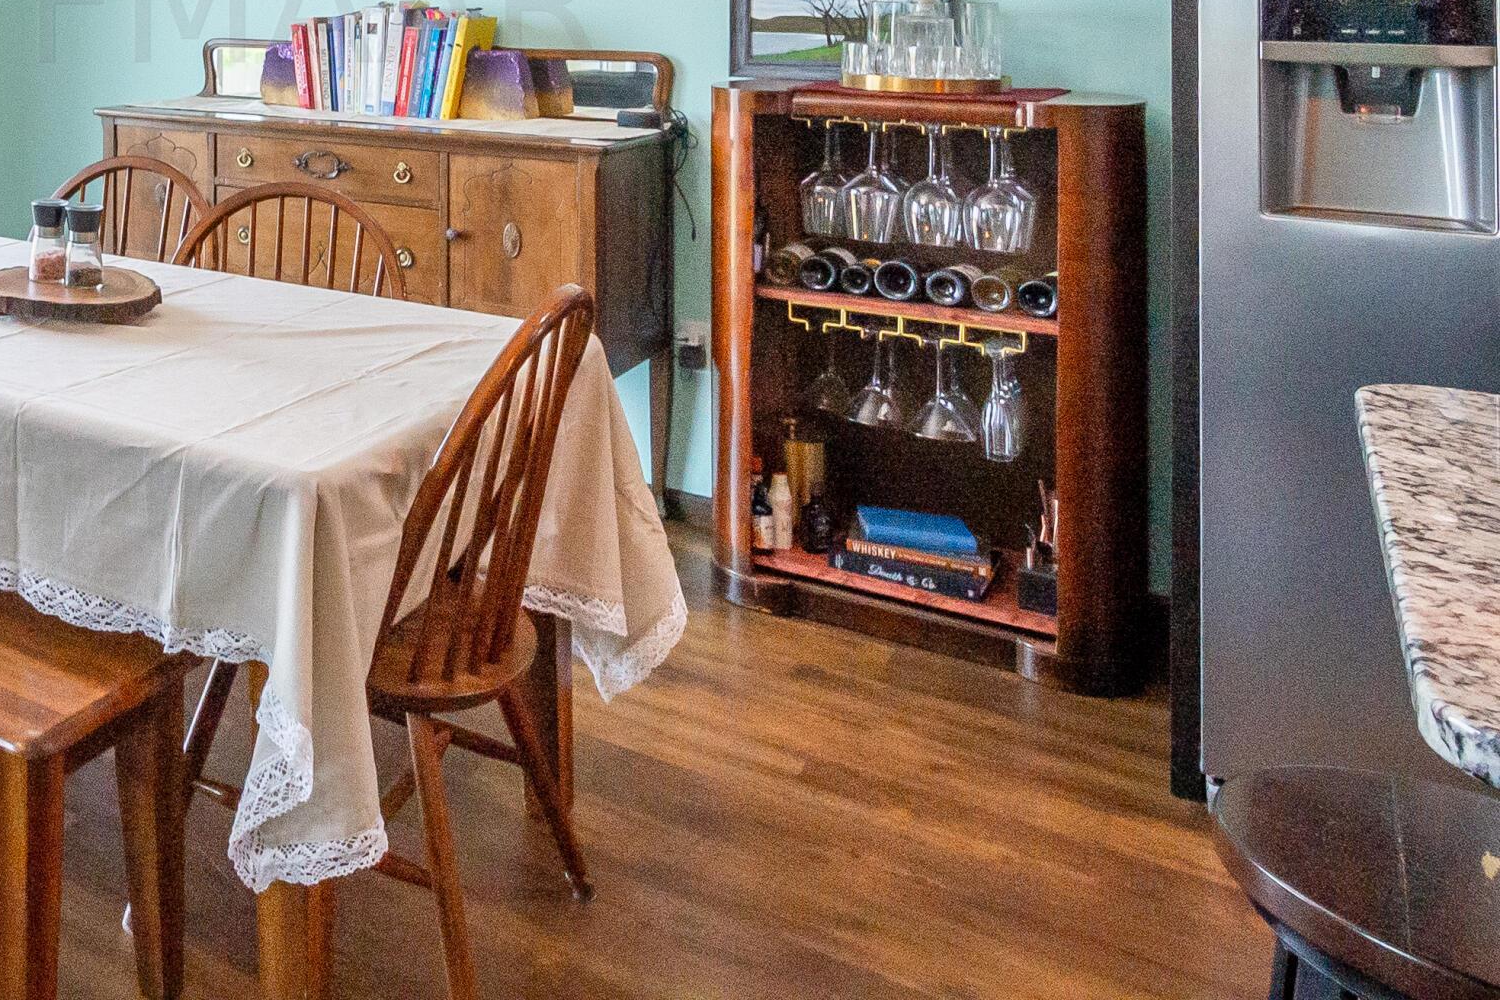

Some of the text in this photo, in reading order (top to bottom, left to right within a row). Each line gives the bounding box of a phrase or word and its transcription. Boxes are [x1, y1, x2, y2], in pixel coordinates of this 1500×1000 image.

[383, 45, 396, 89] BAKING
[852, 542, 896, 559] WHISKEY
[867, 564, 903, 581] Death
